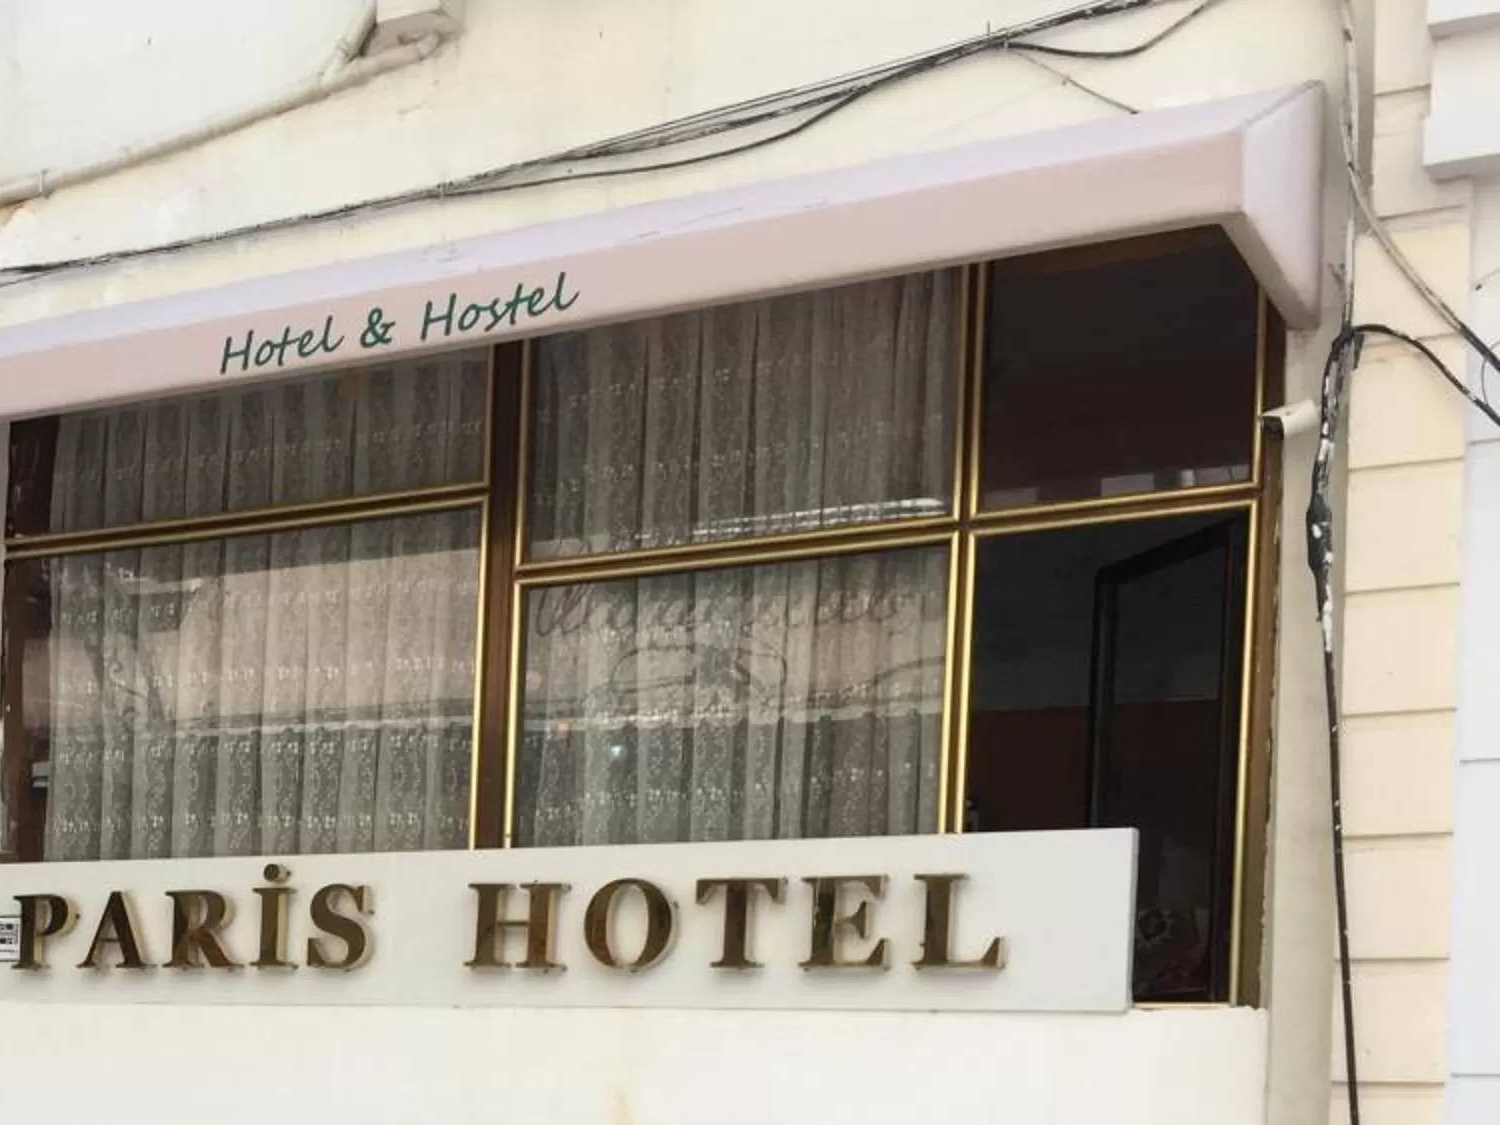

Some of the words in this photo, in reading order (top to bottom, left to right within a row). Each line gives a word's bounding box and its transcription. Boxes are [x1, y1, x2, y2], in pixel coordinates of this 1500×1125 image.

[219, 315, 345, 375] Hotel
[360, 307, 397, 349] &
[420, 271, 581, 341] Hostel
[463, 872, 1008, 974] HOTEL
